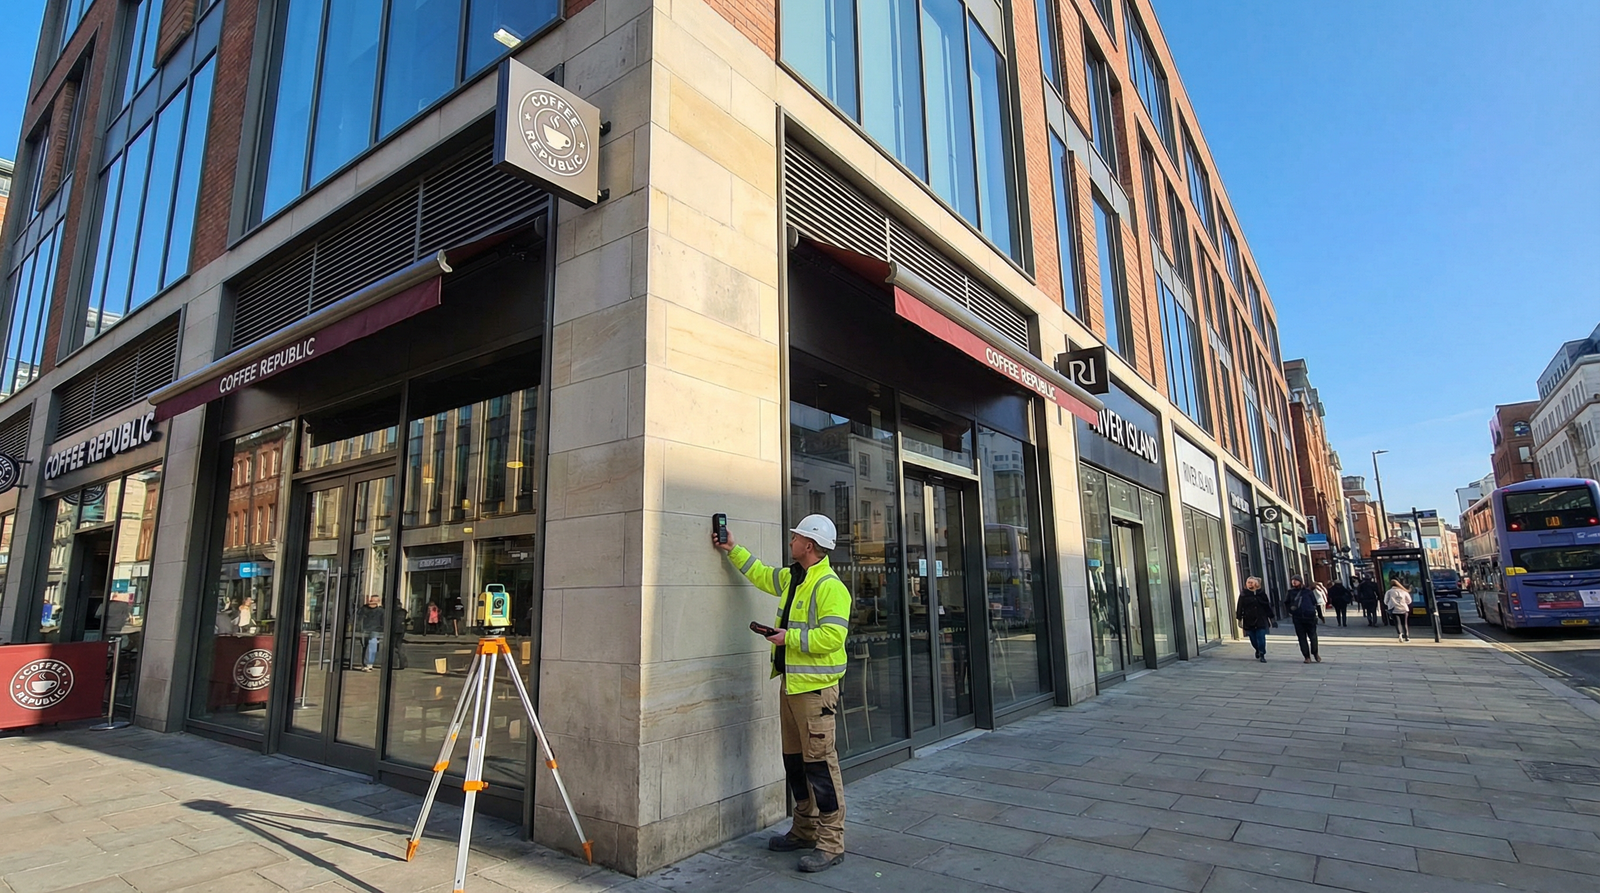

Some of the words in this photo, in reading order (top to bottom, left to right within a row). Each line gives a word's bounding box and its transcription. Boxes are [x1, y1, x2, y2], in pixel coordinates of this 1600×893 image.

[531, 94, 580, 128] COFFEE
[525, 130, 583, 171] REPUBLIC
[219, 363, 258, 393] COFFEE
[260, 337, 316, 377] REPUBLIC
[985, 347, 1020, 380] COFFEE
[1021, 367, 1057, 401] REPUBLIC
[44, 441, 86, 481] COFFEE
[87, 411, 155, 464] REPUBLIC
[1125, 419, 1159, 465] ISLAND
[23, 662, 65, 676] COFFEE
[16, 688, 66, 706] REPUBLIC
